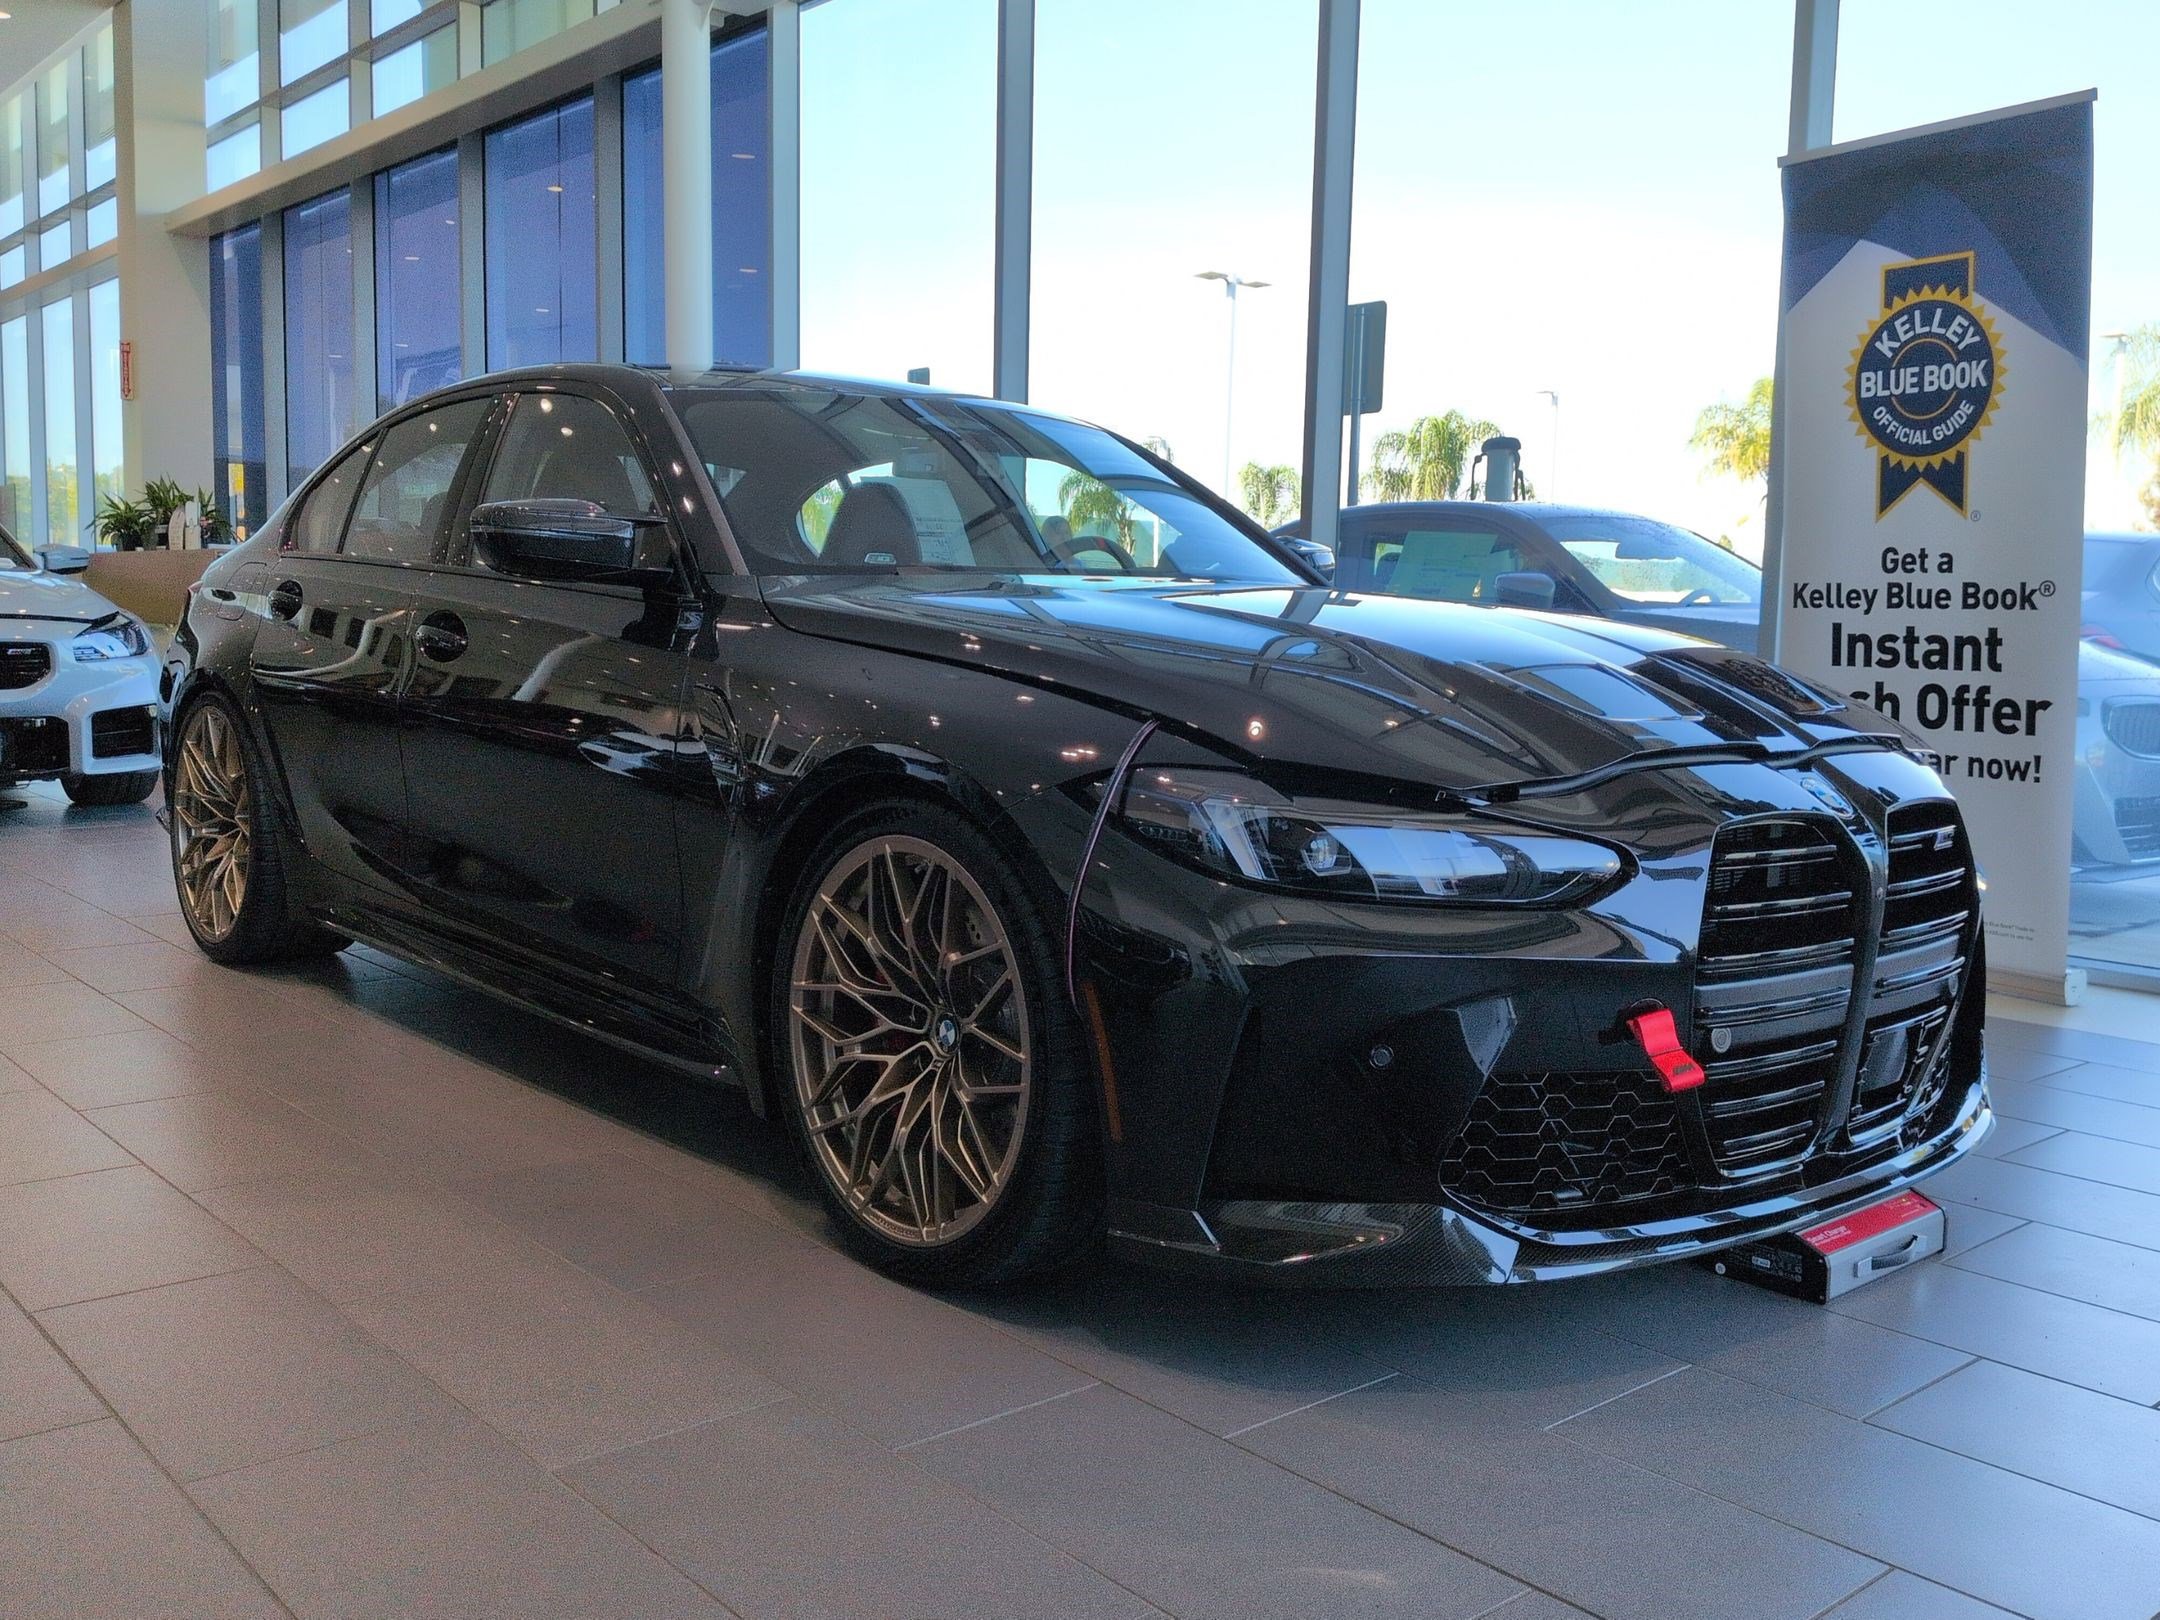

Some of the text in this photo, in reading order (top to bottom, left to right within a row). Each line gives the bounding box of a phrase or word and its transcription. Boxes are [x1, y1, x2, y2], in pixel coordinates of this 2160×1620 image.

[1874, 307, 1981, 359] KELLEY
[1860, 359, 1989, 399] BLUE BOOK
[1873, 399, 1975, 445] OFFICIAL GUIDE
[1881, 546, 1954, 574] Get a
[1792, 582, 1878, 615] Kelley
[1886, 581, 1951, 610] Blue
[1831, 622, 2003, 673] Instant
[1916, 683, 2053, 736] Offer
[1968, 755, 2042, 783] now!
